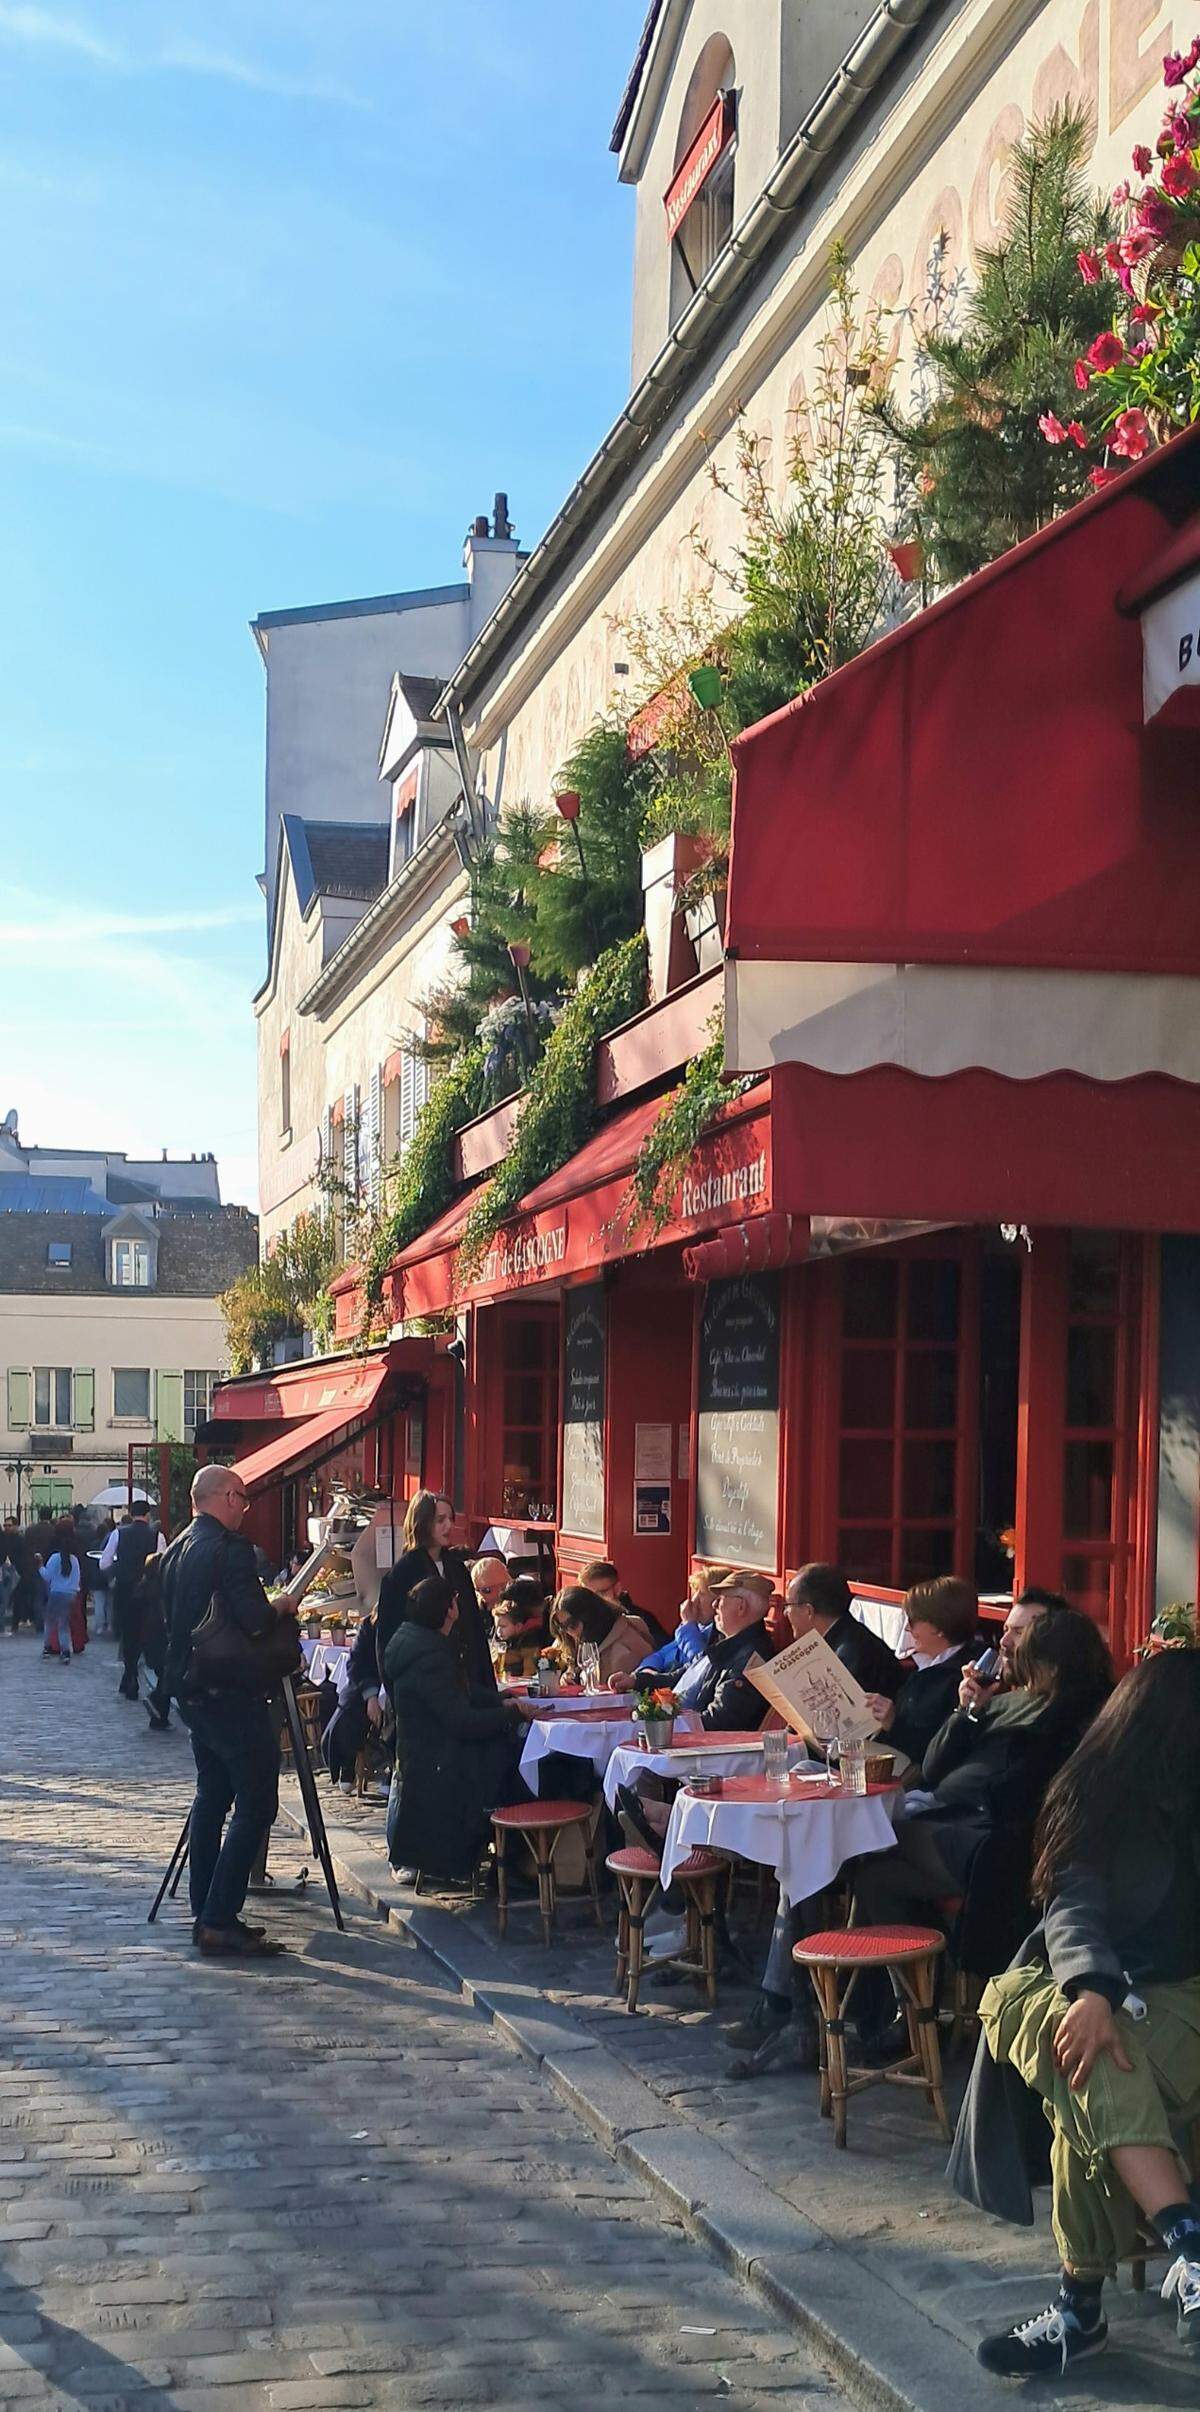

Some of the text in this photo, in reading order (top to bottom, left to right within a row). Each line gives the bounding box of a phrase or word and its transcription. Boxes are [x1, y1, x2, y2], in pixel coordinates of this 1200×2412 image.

[1179, 629, 1200, 673] B
[682, 1149, 766, 1219] Restaurant
[501, 1249, 513, 1277] de
[514, 1226, 566, 1274] GASCOGNE
[780, 1641, 819, 1670] Gascogne
